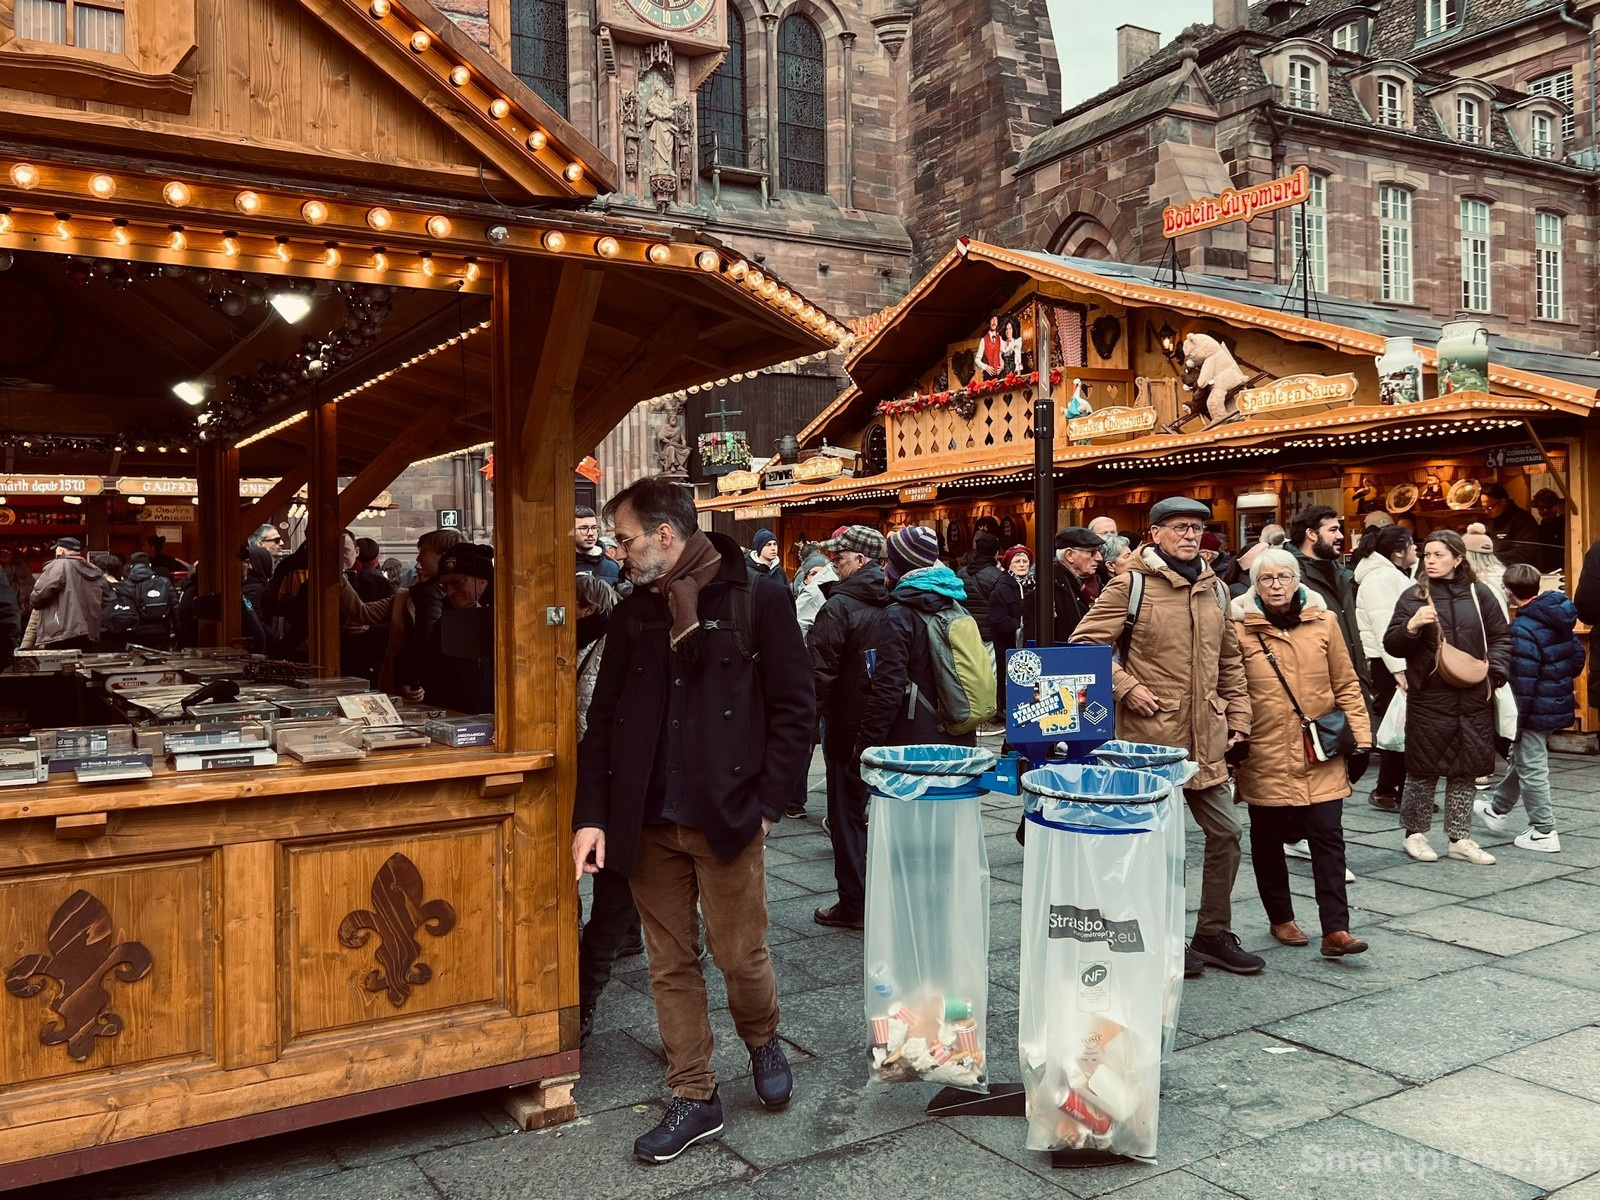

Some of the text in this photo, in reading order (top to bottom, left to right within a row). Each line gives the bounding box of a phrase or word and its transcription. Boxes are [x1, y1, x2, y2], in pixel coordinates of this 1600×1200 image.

[1164, 173, 1303, 232] Bodein-Guyomard
[1286, 389, 1302, 403] en
[1304, 383, 1344, 401] Sauce
[32, 480, 58, 493] depuis
[59, 479, 85, 492] 1570
[1084, 969, 1105, 983] NF
